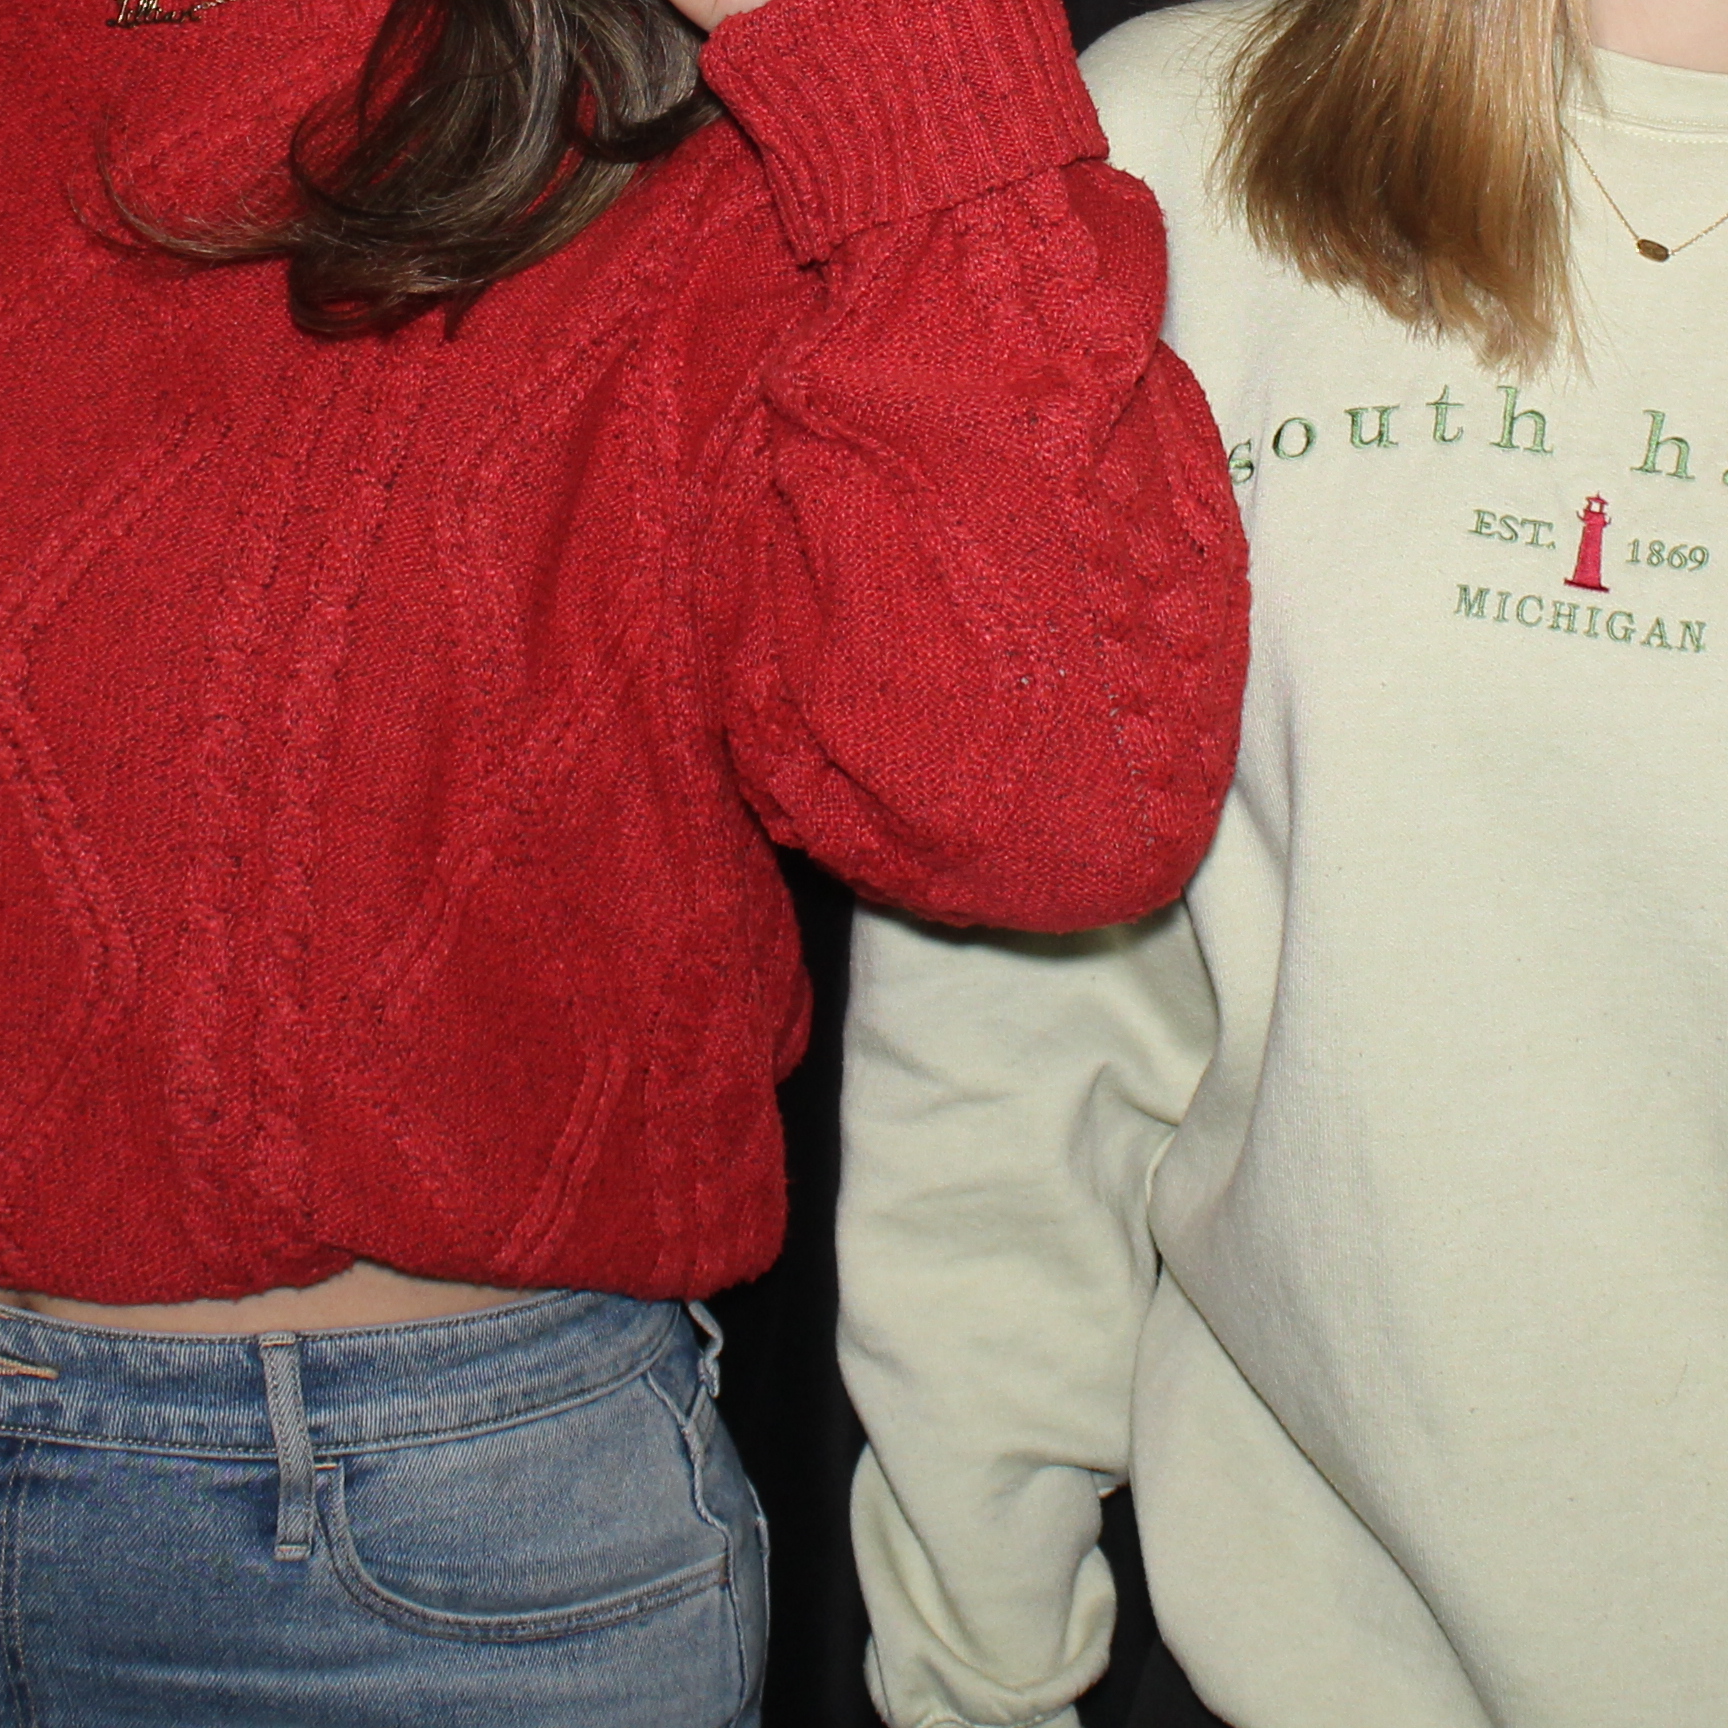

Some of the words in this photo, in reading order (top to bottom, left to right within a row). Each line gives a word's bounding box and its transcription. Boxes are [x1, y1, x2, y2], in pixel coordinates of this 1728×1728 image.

[1228, 384, 1554, 485] south
[1468, 508, 1557, 550] EST.
[1625, 538, 1710, 572] 1869
[1453, 583, 1707, 653] MICHIGAN
